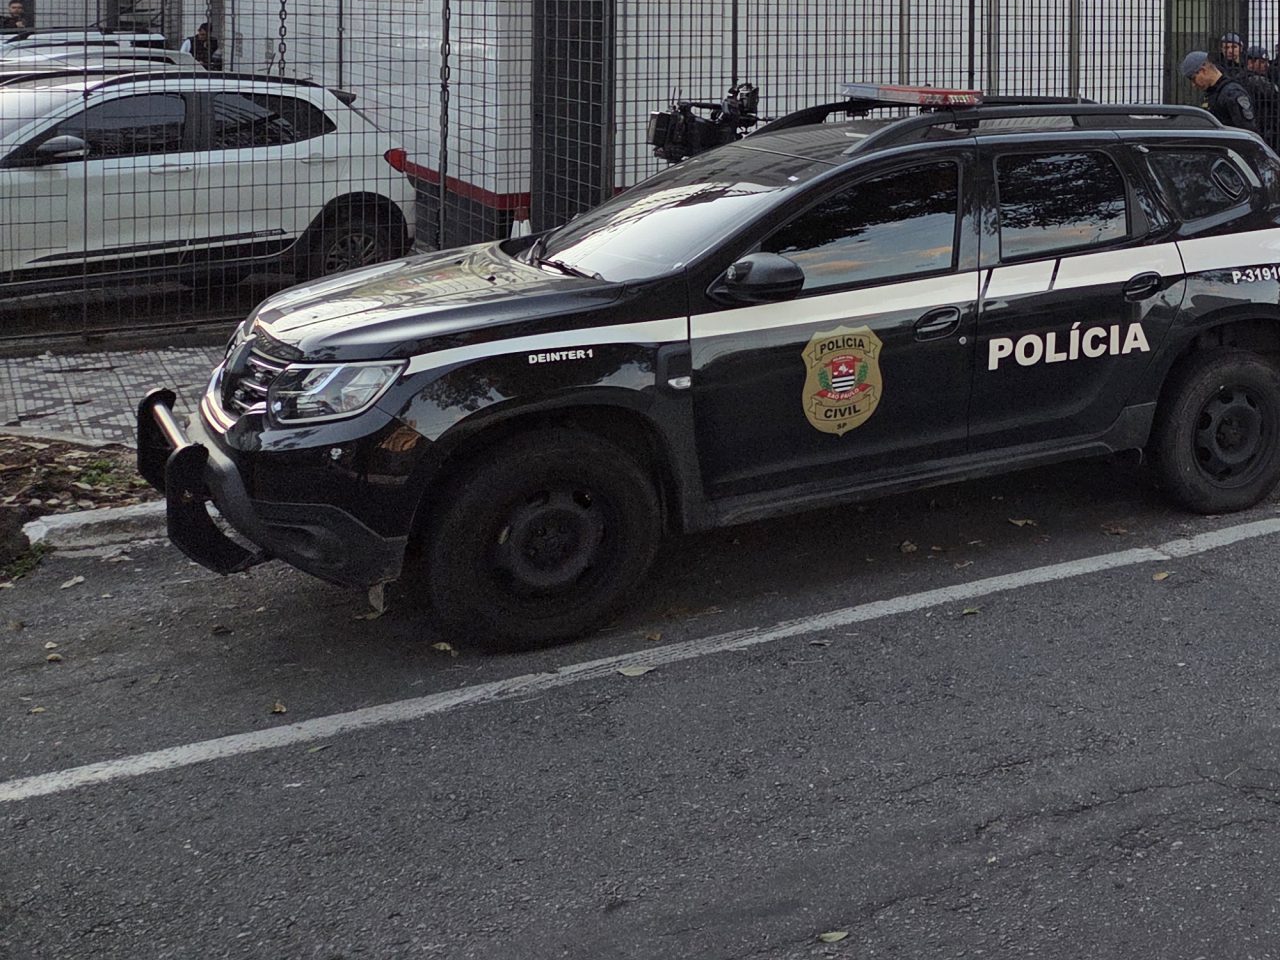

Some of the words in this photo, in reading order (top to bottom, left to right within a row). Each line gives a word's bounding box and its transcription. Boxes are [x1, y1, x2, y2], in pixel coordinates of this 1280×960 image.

[820, 335, 865, 354] POLÍCIA
[988, 321, 1151, 370] POLÍCIA
[528, 349, 586, 364] DEINTER
[824, 405, 861, 419] CIVIL
